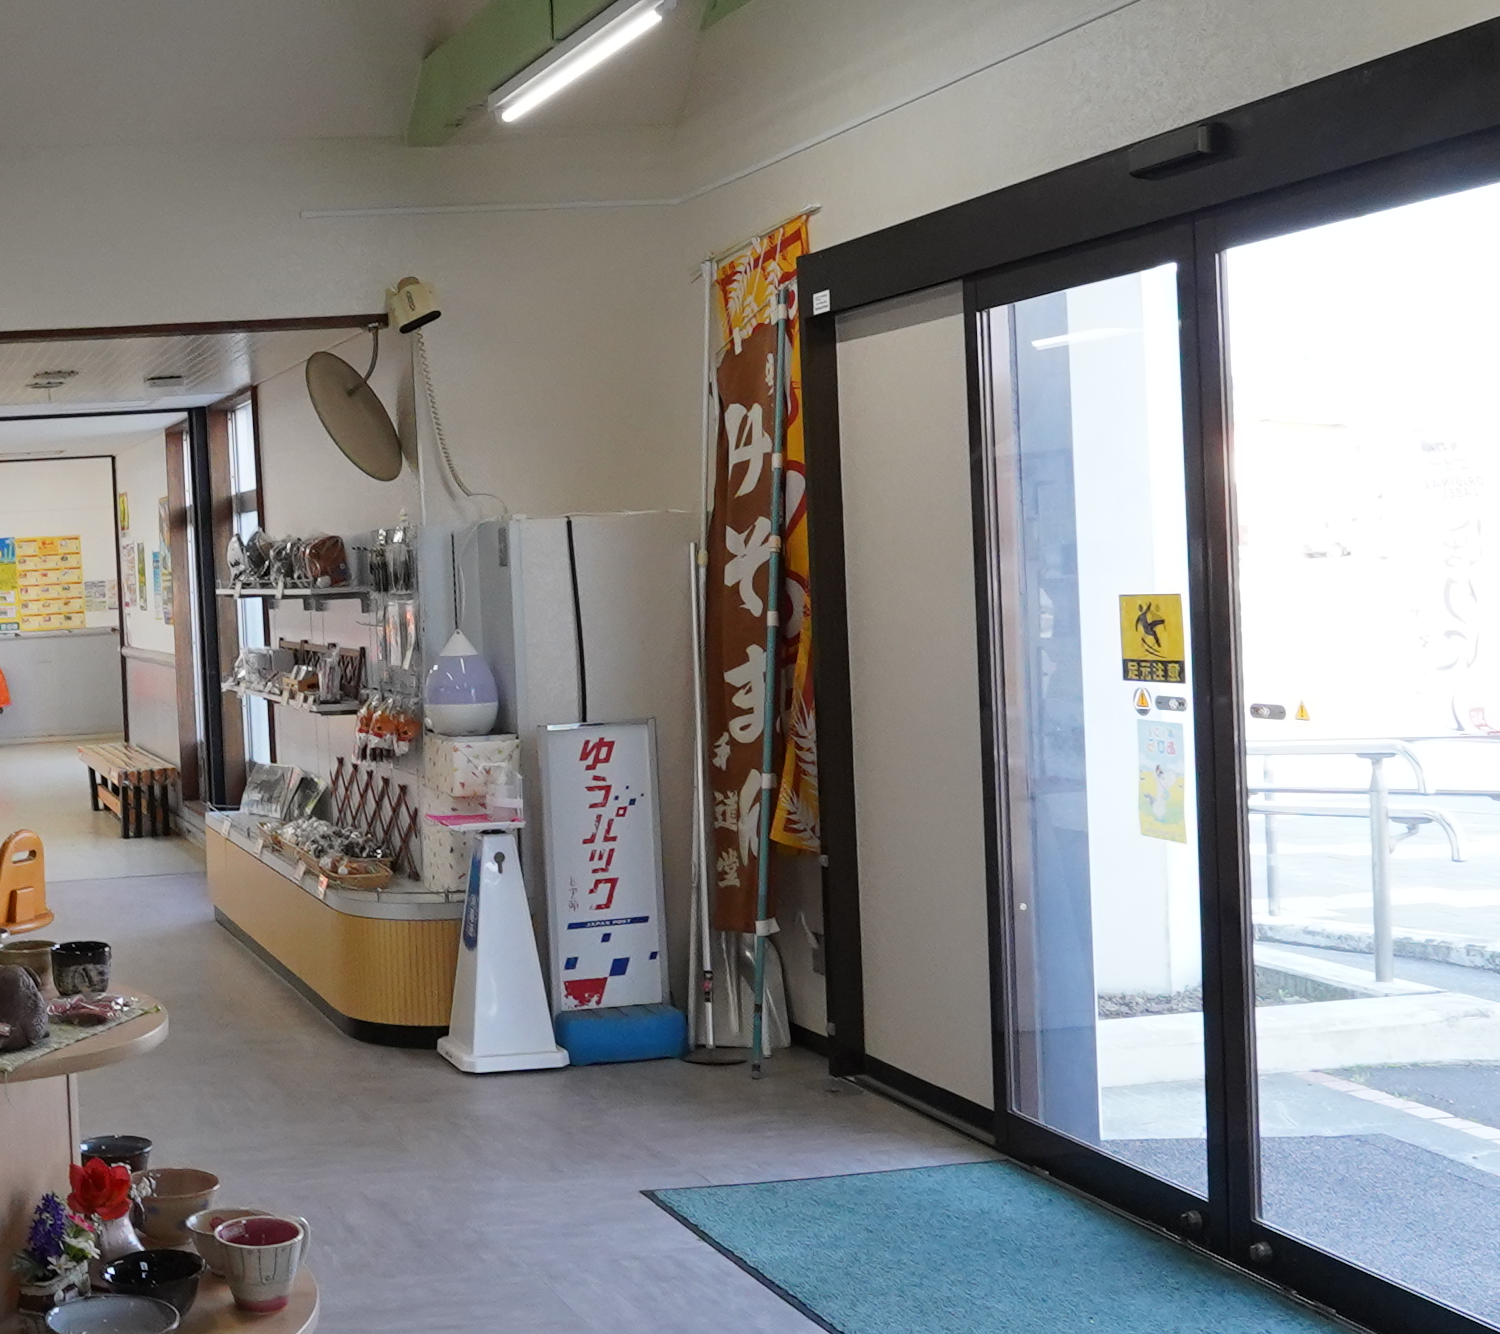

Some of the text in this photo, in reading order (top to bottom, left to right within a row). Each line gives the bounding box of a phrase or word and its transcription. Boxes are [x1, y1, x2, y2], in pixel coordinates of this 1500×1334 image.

[1127, 662, 1180, 681] 足元注意
[578, 737, 619, 910] ゆうパック
